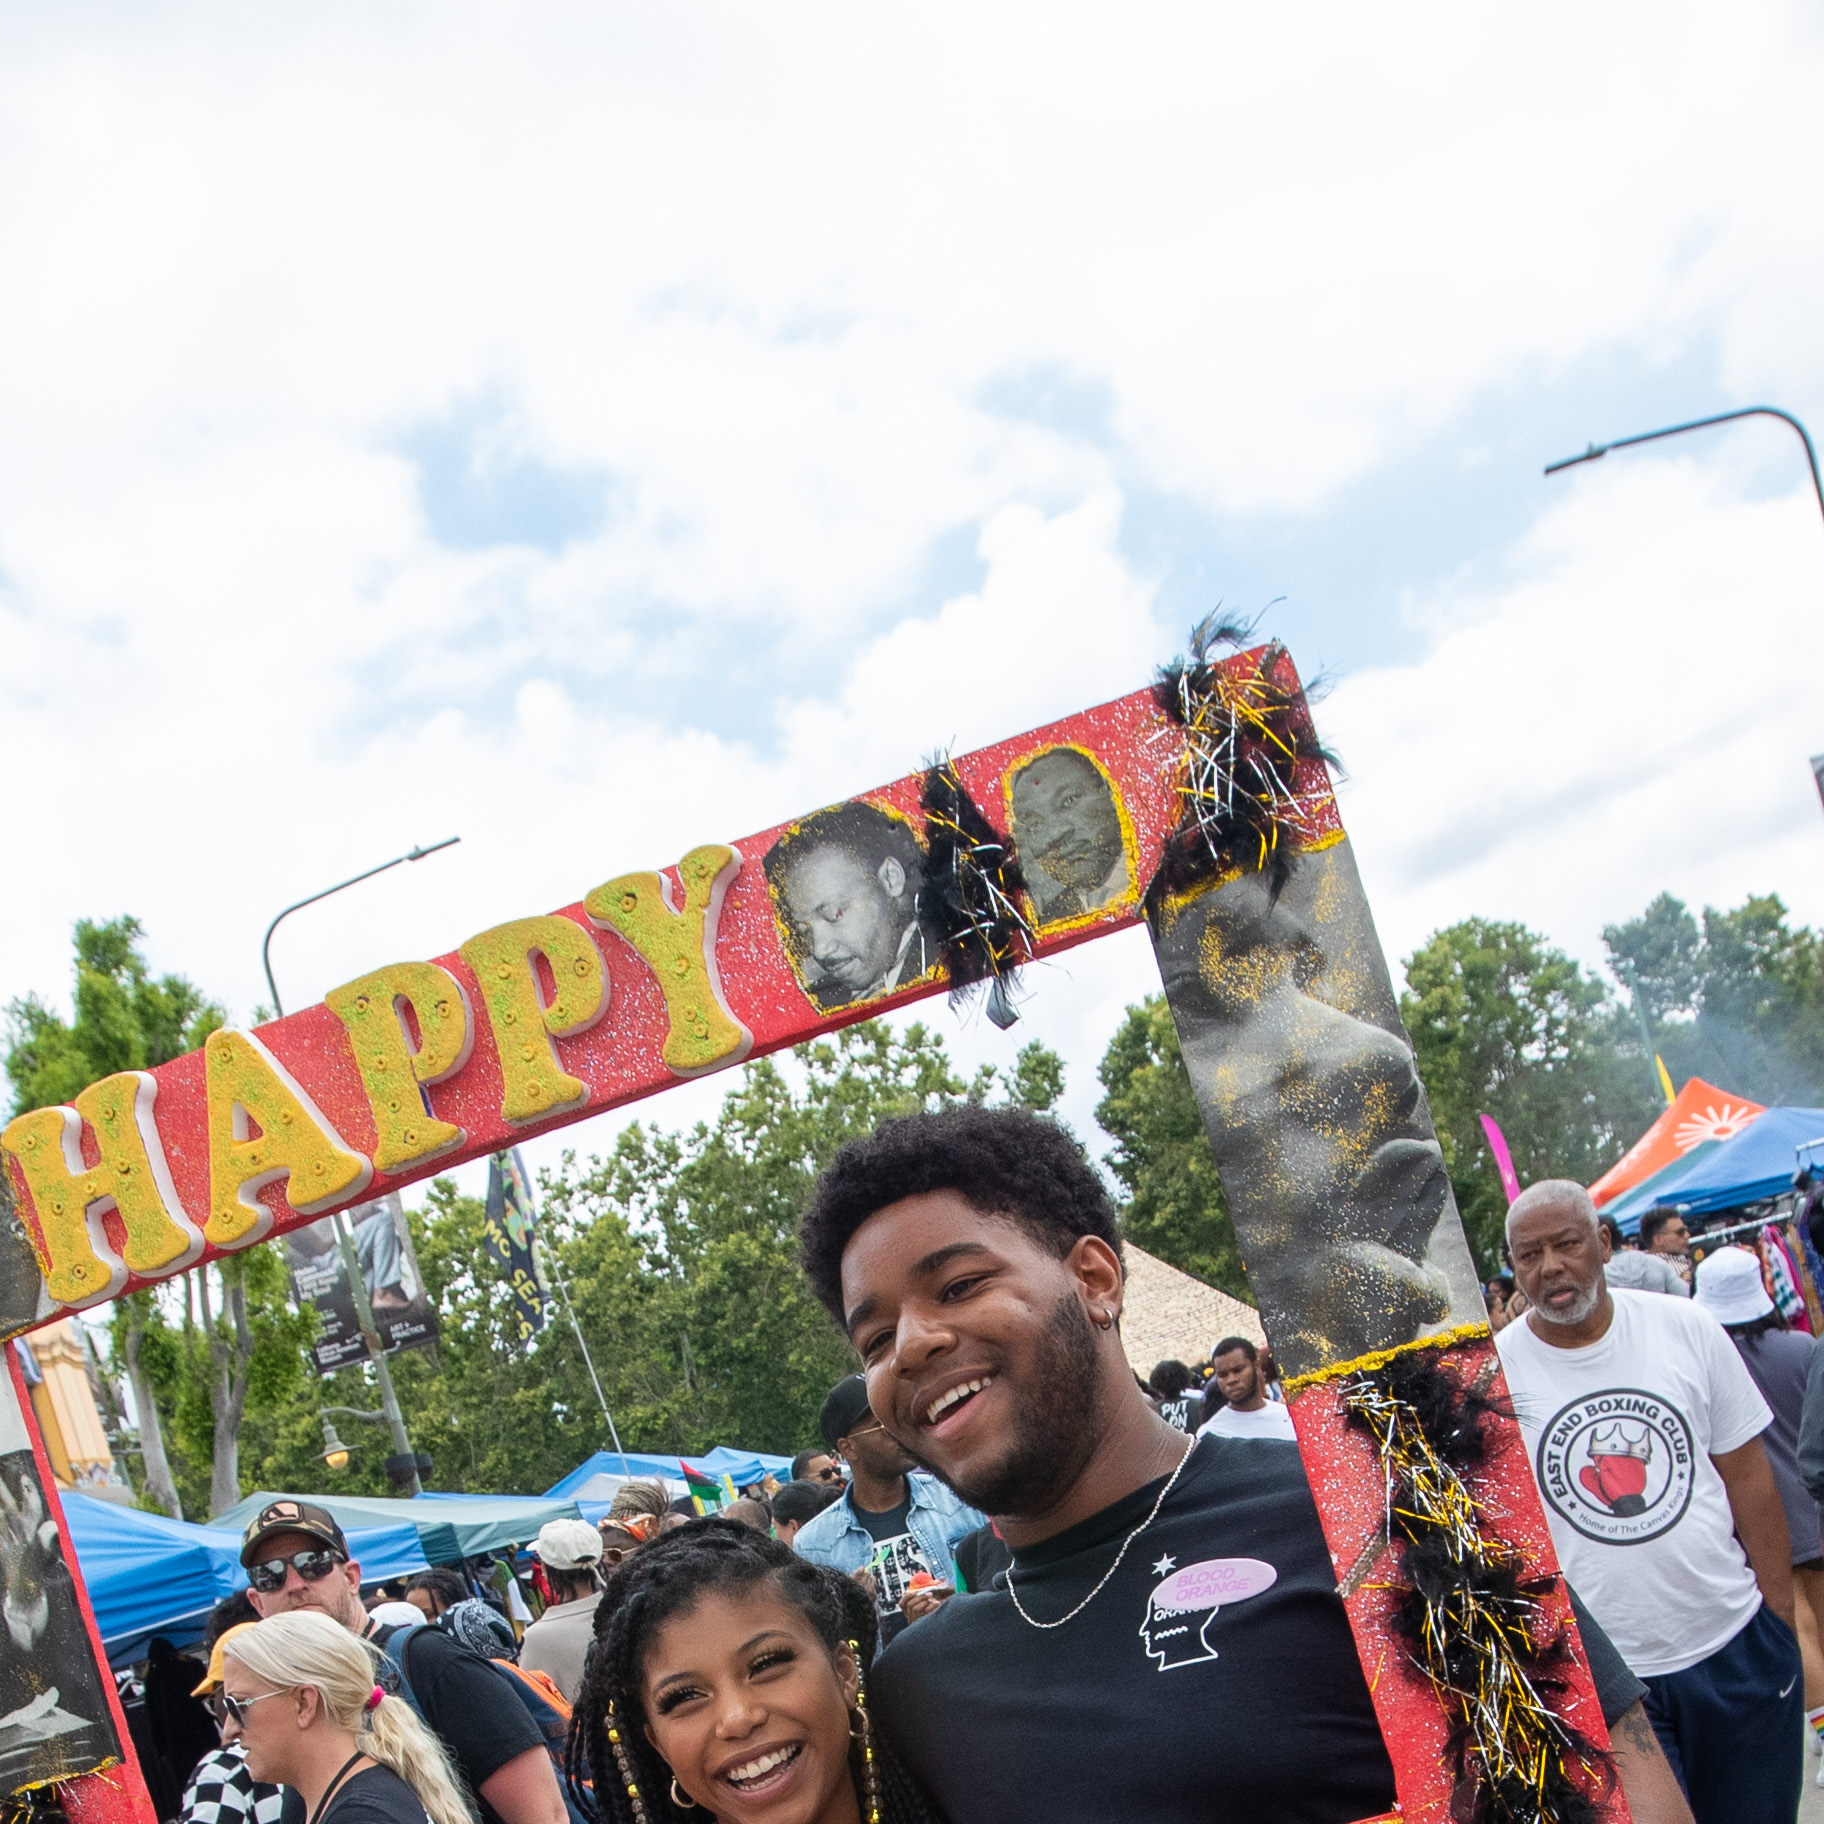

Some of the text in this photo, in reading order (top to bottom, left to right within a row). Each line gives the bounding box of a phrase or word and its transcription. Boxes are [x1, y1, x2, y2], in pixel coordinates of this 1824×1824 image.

[0, 844, 753, 1307] HAPPY
[1161, 1400, 1189, 1417] PUT
[1169, 1412, 1188, 1428] ON
[1547, 1398, 1688, 1498] EAST END BOXING CLUB
[1579, 1487, 1685, 1534] Home of The Canvas Kings
[1176, 1567, 1236, 1588] BLOOD
[1175, 1578, 1250, 1603] ORANGE
